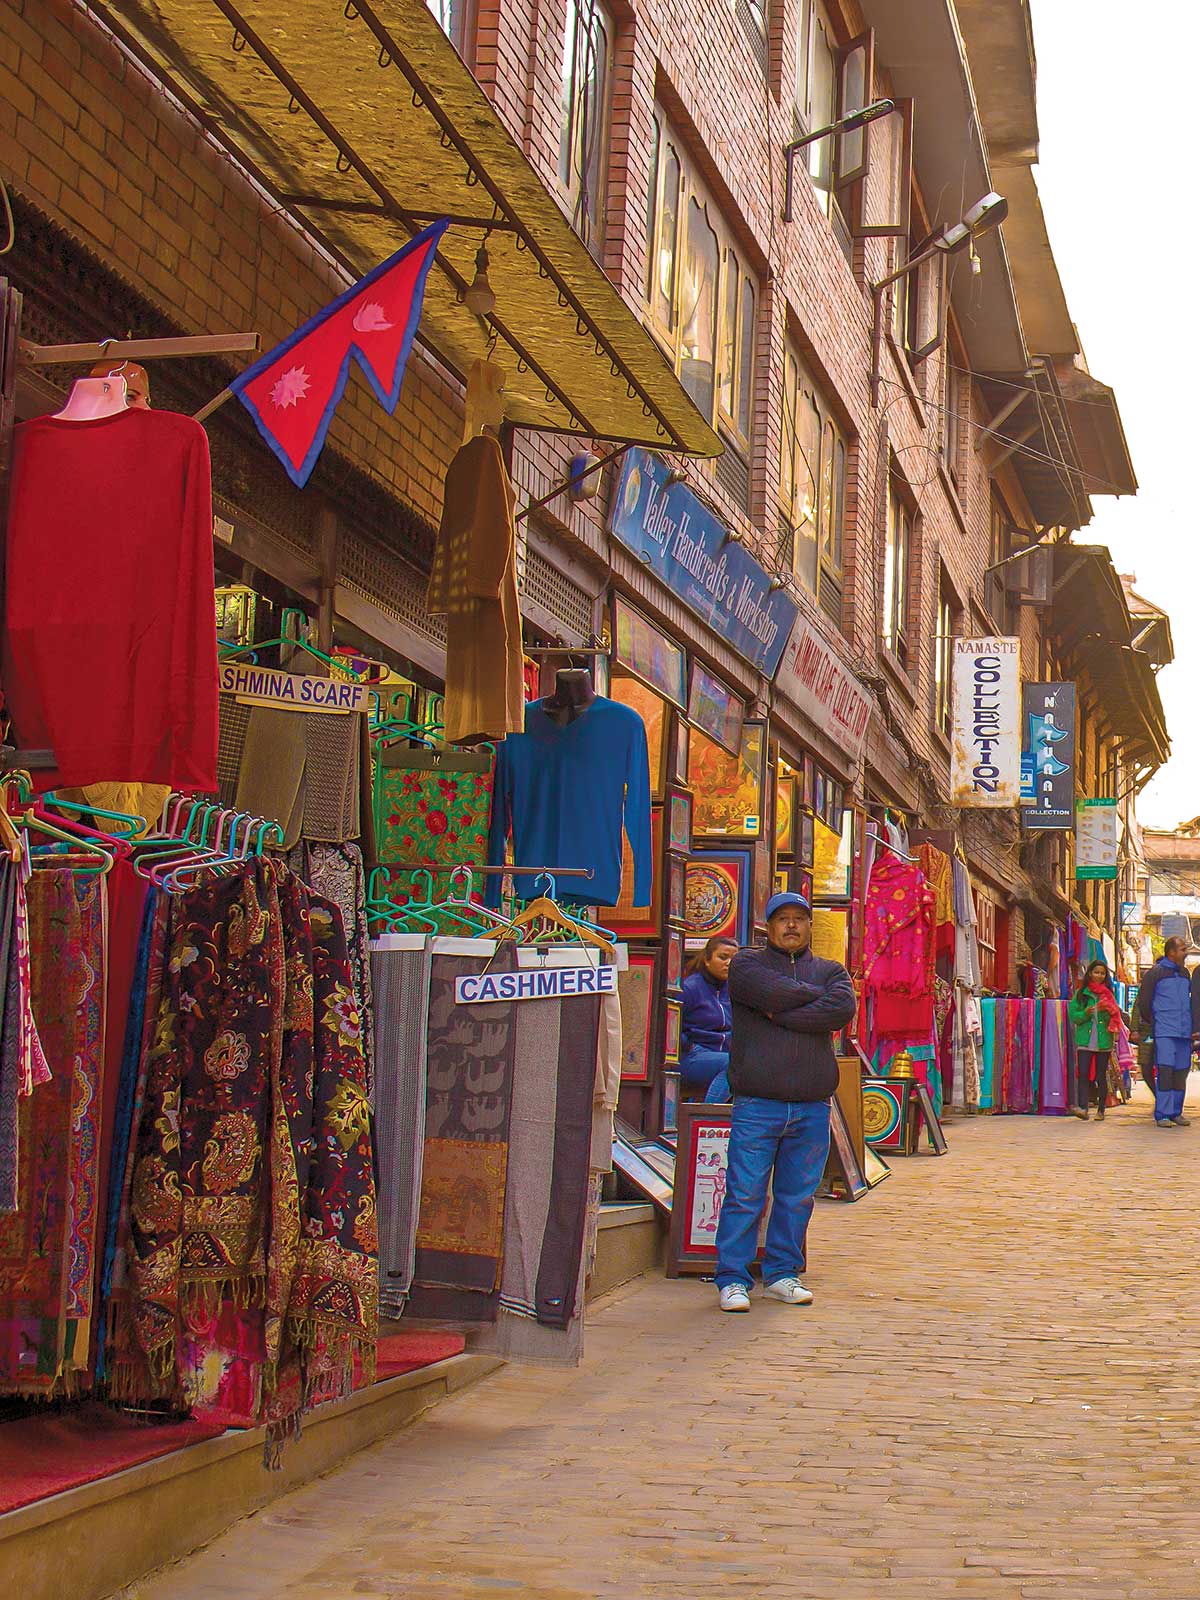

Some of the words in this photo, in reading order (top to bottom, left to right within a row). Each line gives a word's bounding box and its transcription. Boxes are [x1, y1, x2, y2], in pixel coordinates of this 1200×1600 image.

[643, 482, 677, 557] Valley
[671, 511, 730, 602] Handicrafts
[727, 583, 737, 611] &
[735, 574, 778, 656] Workshop
[957, 642, 1017, 654] NAMASTE
[218, 668, 295, 699] SHMINA
[301, 679, 362, 708] SCARF
[972, 656, 1001, 793] COLLECTION
[1025, 809, 1070, 817] COLLECTION
[460, 968, 613, 1001] CASHMERE
